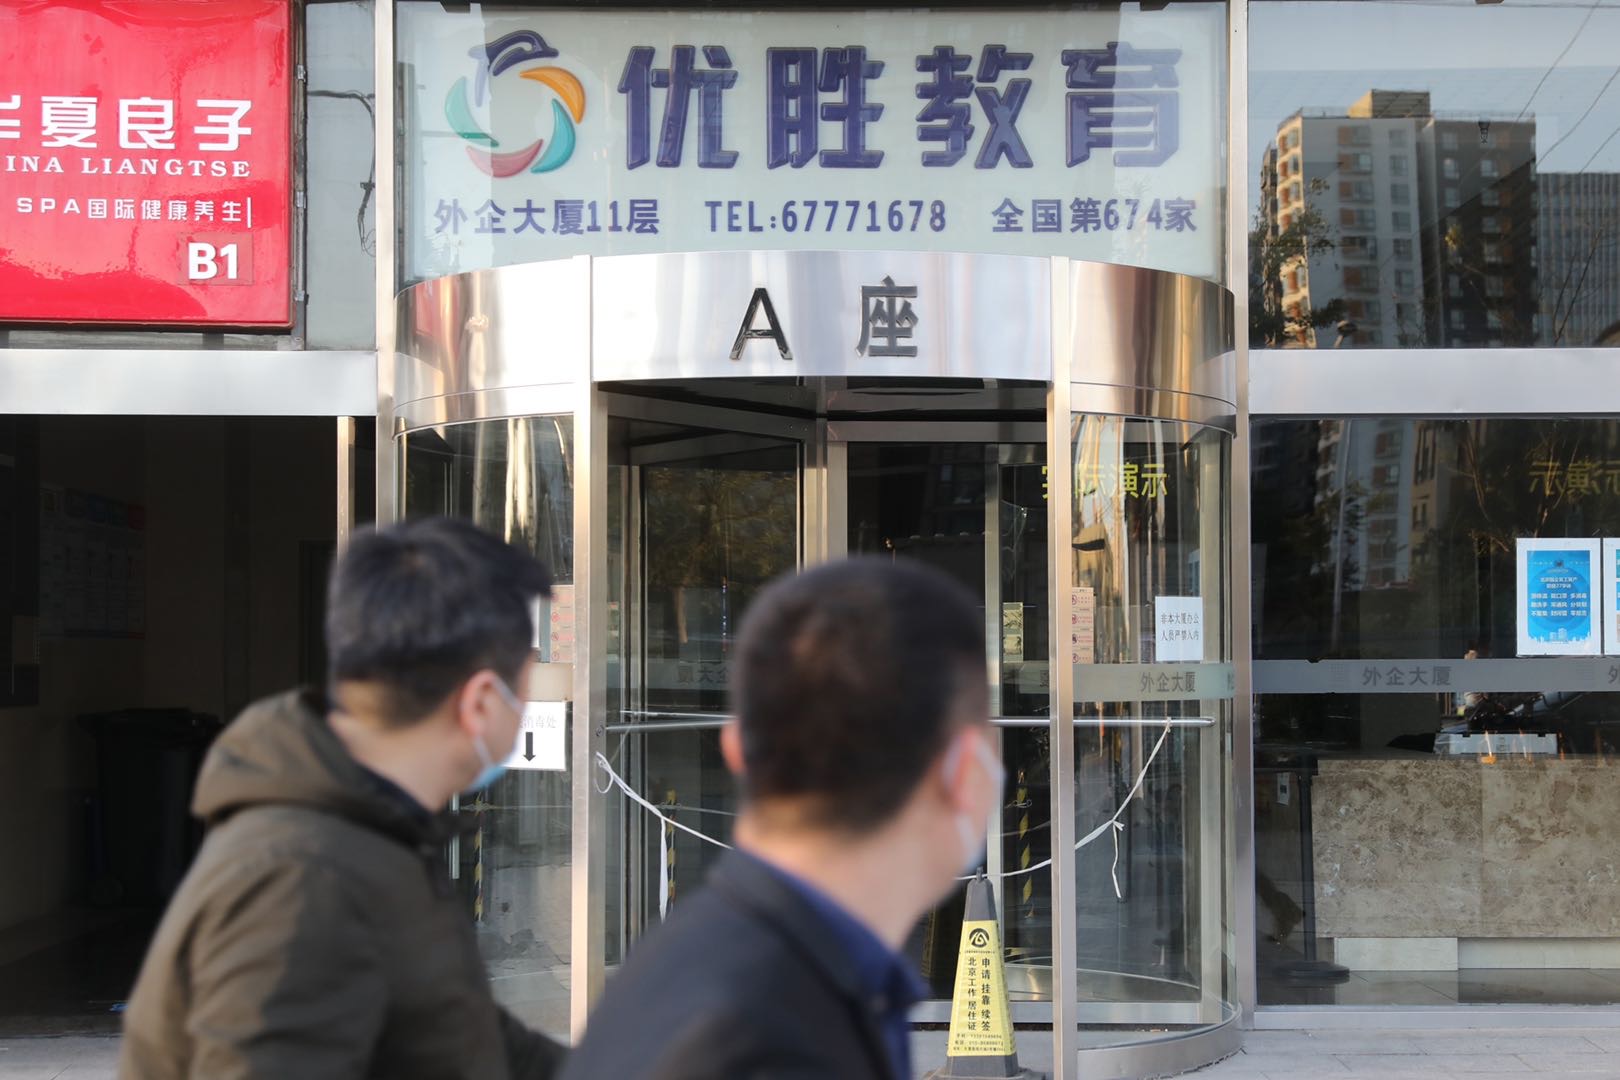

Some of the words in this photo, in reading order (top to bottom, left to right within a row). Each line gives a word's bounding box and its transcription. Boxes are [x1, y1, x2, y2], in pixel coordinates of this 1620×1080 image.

[616, 42, 1183, 171] 优胜教育
[81, 157, 251, 177] LIANGTSE
[433, 198, 660, 235] 外企大厦11层
[705, 199, 947, 235] TEL:67771678
[992, 197, 1198, 235] 全国第674家
[188, 243, 238, 280] B1
[729, 287, 792, 362] A
[855, 276, 918, 359] 座
[1041, 462, 1168, 498] 际演示
[1161, 613, 1199, 624] 非本大厦办公
[1141, 671, 1196, 693] 外企大厦
[1362, 666, 1450, 686] 外企大厦
